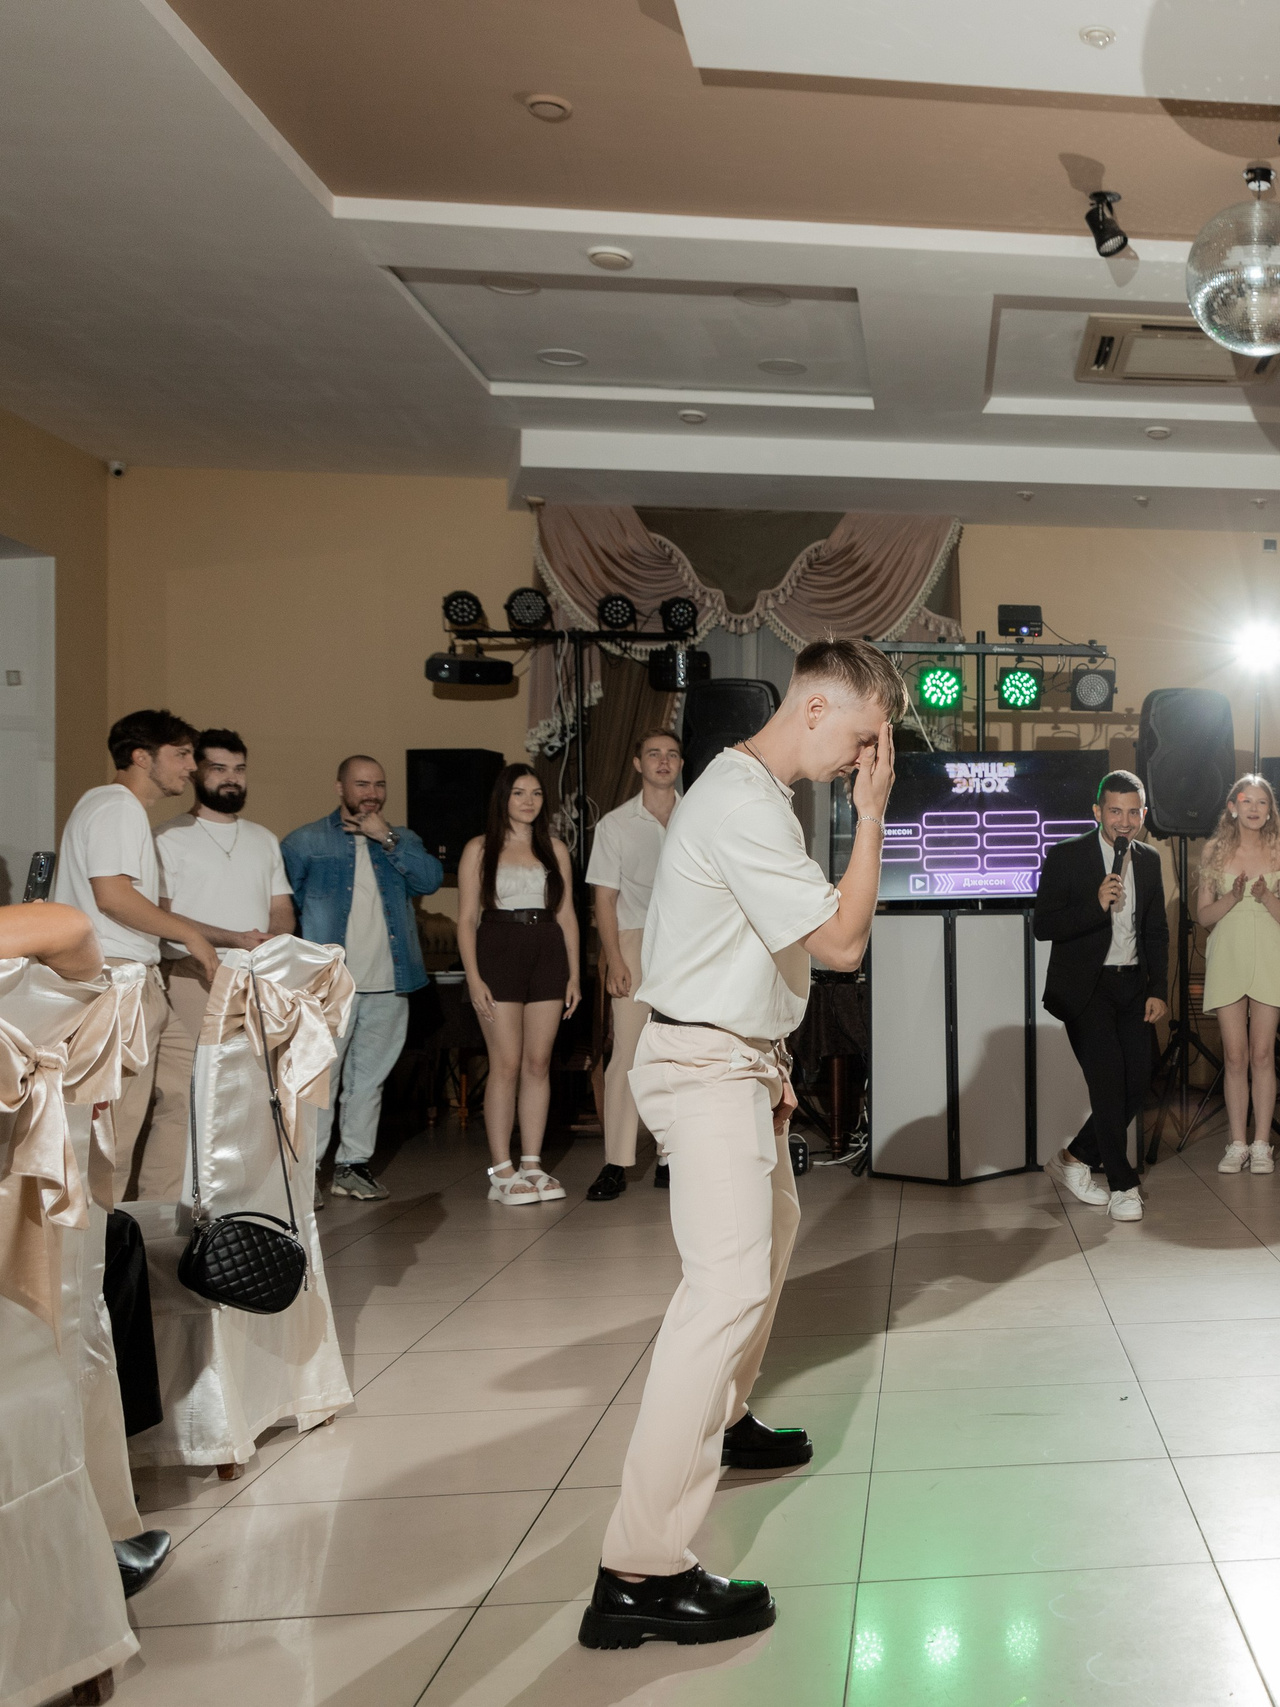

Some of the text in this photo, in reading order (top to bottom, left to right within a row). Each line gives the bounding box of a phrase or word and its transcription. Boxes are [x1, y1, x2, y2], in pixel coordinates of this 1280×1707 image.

[944, 762, 1016, 779] ТАНЦЫ
[951, 777, 1009, 793] ЭПОХ
[963, 877, 1006, 887] Джексон
